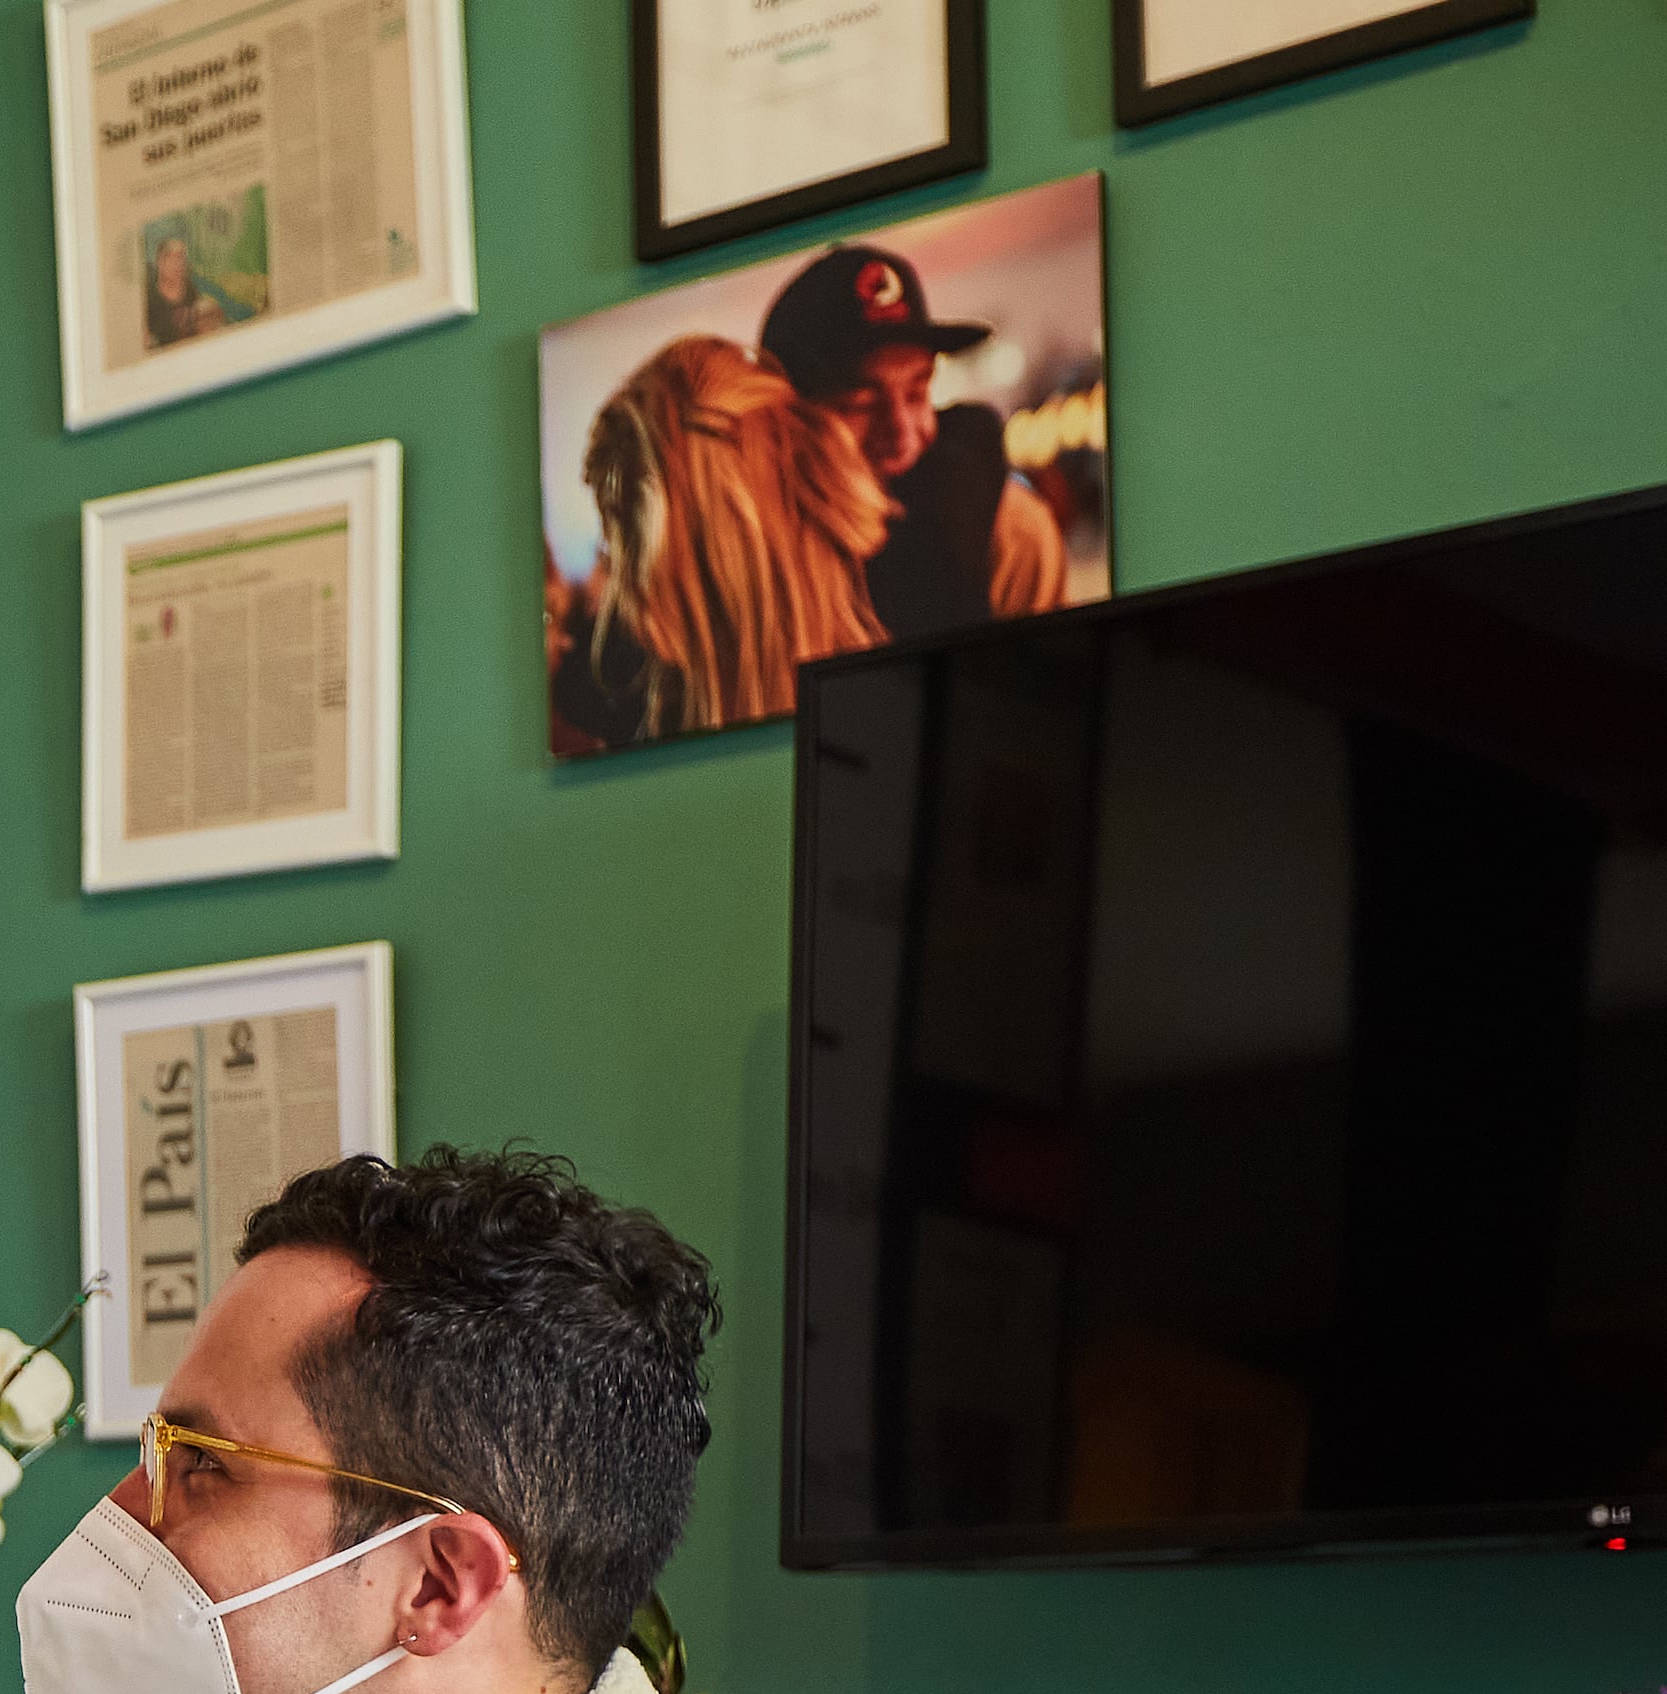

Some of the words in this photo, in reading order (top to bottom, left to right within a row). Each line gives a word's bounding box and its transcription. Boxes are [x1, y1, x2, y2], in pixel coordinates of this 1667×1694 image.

[138, 1059, 197, 1222] País
[141, 1249, 198, 1329] El
[1611, 1505, 1632, 1525] LG
